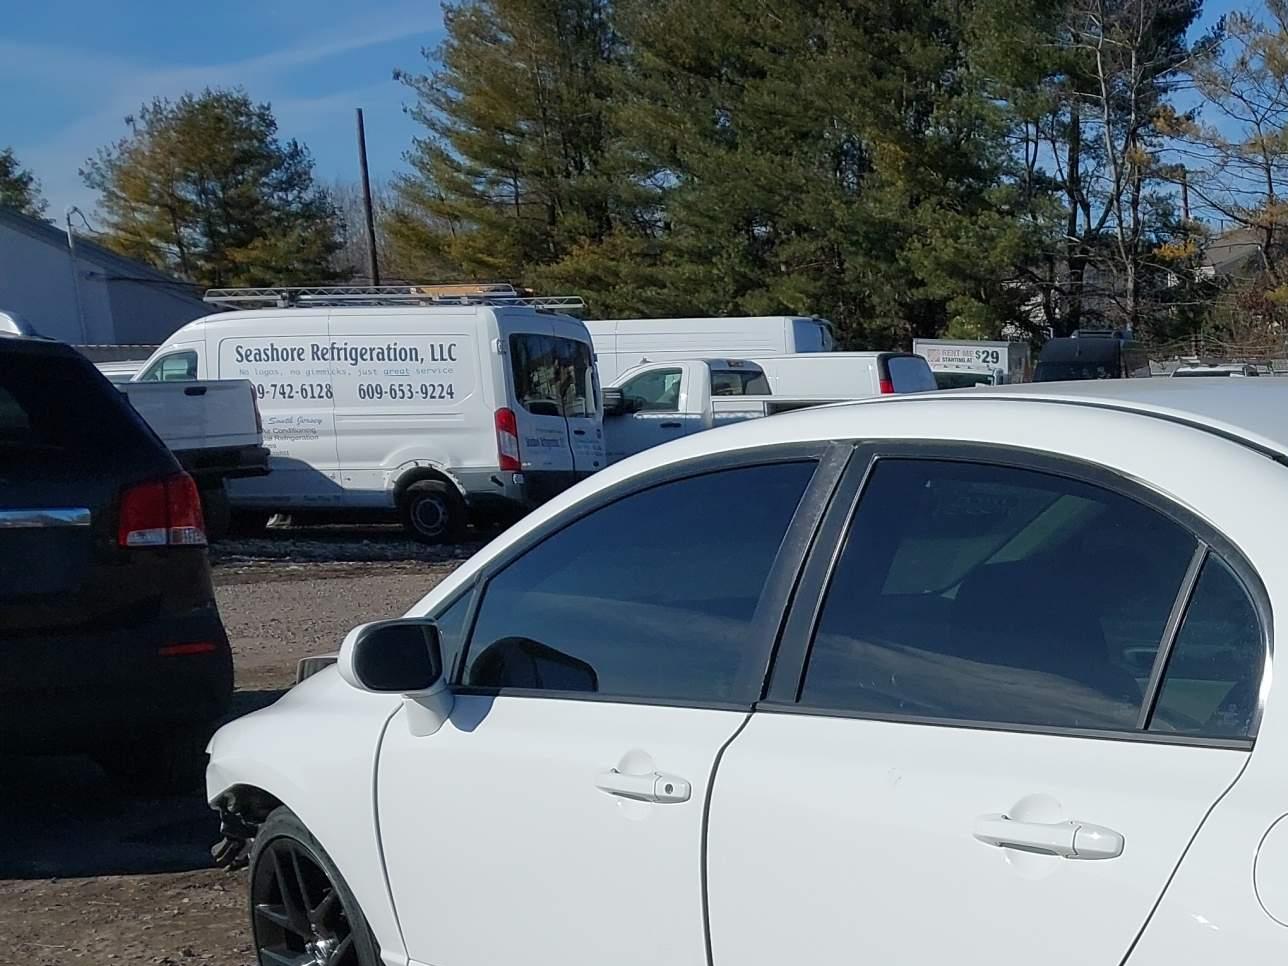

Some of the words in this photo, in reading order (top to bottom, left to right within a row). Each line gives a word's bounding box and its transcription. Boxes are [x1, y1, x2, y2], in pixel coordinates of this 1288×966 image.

[235, 342, 305, 363] Seashore
[310, 341, 425, 366] Refrigeration,
[430, 343, 457, 362] LLC
[975, 350, 1000, 365] $29
[239, 368, 250, 376] No
[356, 367, 377, 377] just
[383, 367, 410, 376] great
[415, 367, 454, 376] service
[257, 383, 334, 400] 9-742-6128
[358, 383, 455, 400] 609-653-9224
